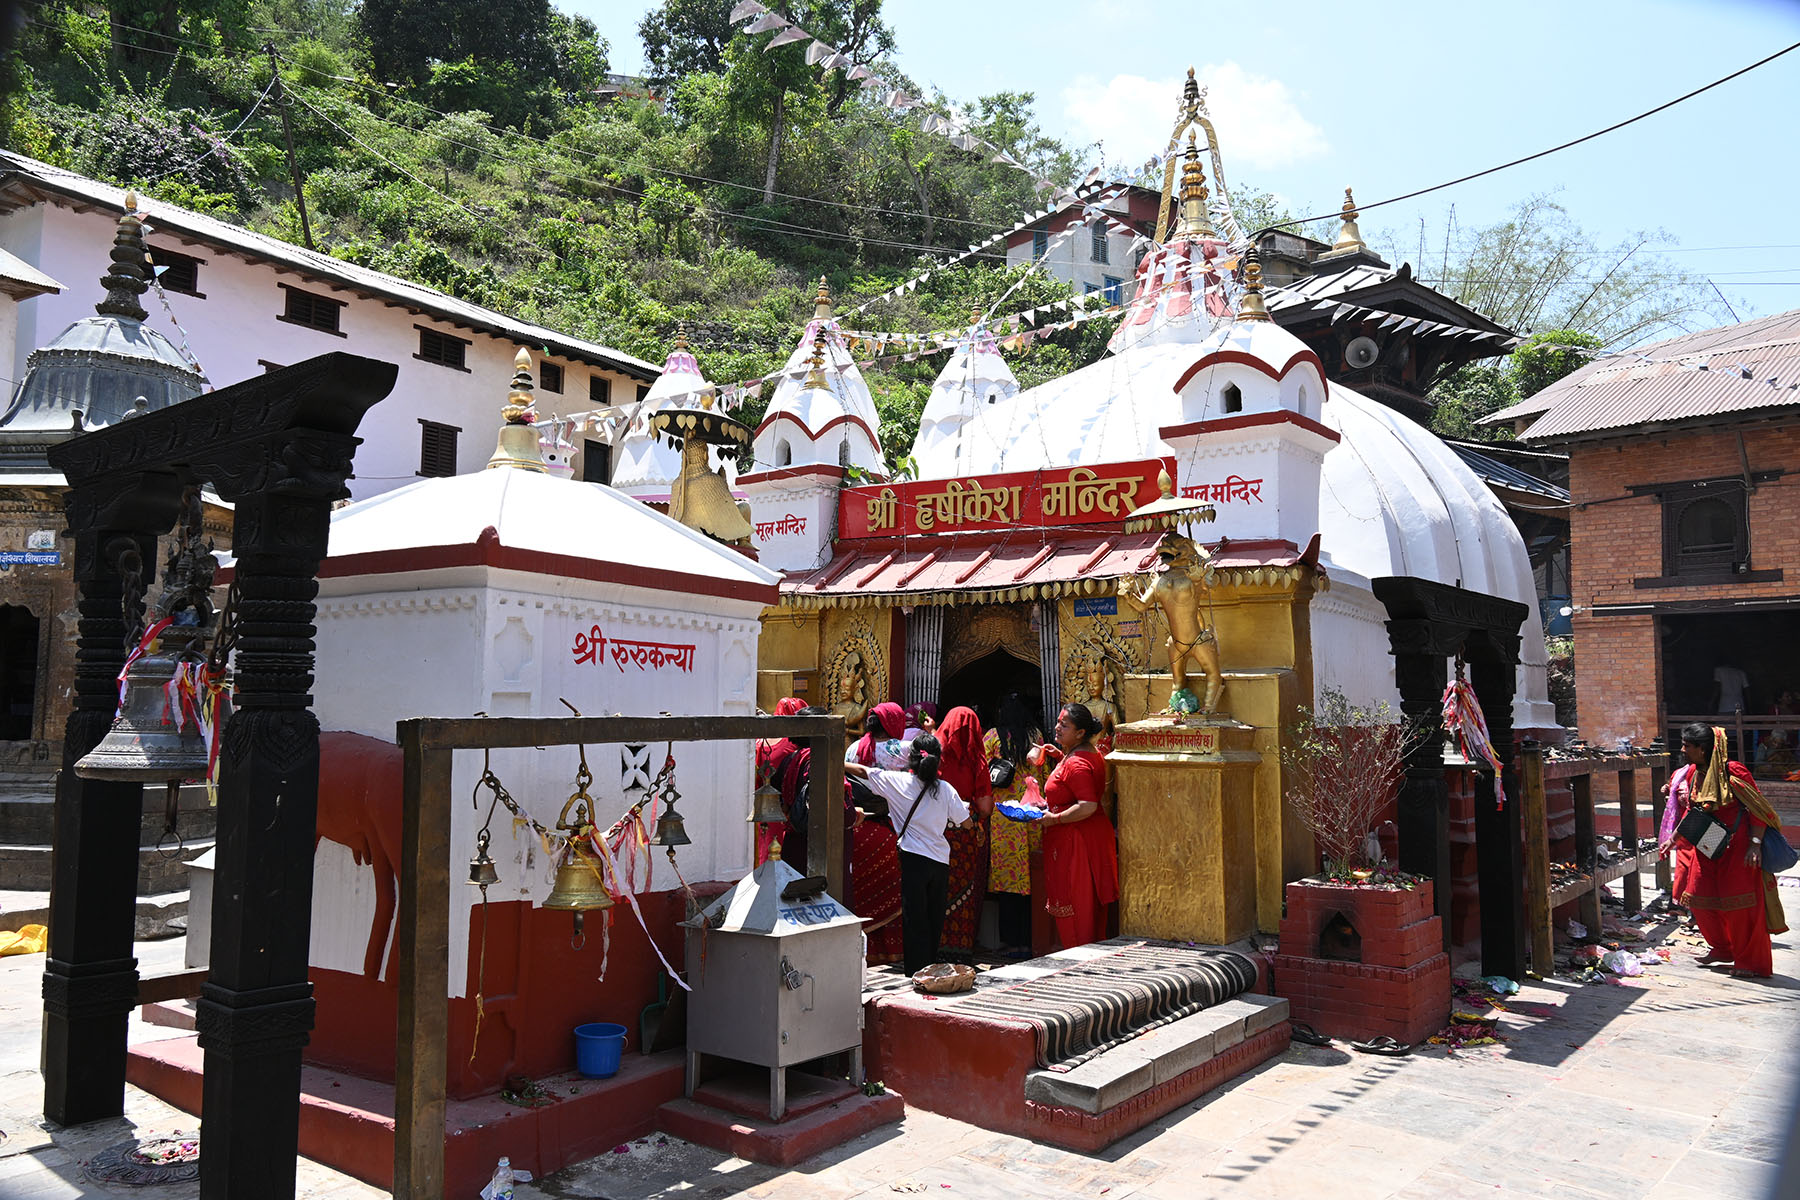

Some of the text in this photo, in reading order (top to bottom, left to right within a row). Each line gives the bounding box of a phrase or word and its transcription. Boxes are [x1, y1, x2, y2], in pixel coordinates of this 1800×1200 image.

[867, 467, 1145, 532] श्री हृषीकेश मन्दिर
[1181, 474, 1264, 505] मल मन्दिर
[755, 513, 807, 542] मूल मन्दिर
[25, 552, 57, 564] शिवालय
[572, 624, 697, 673] श्री रुरुकन्या
